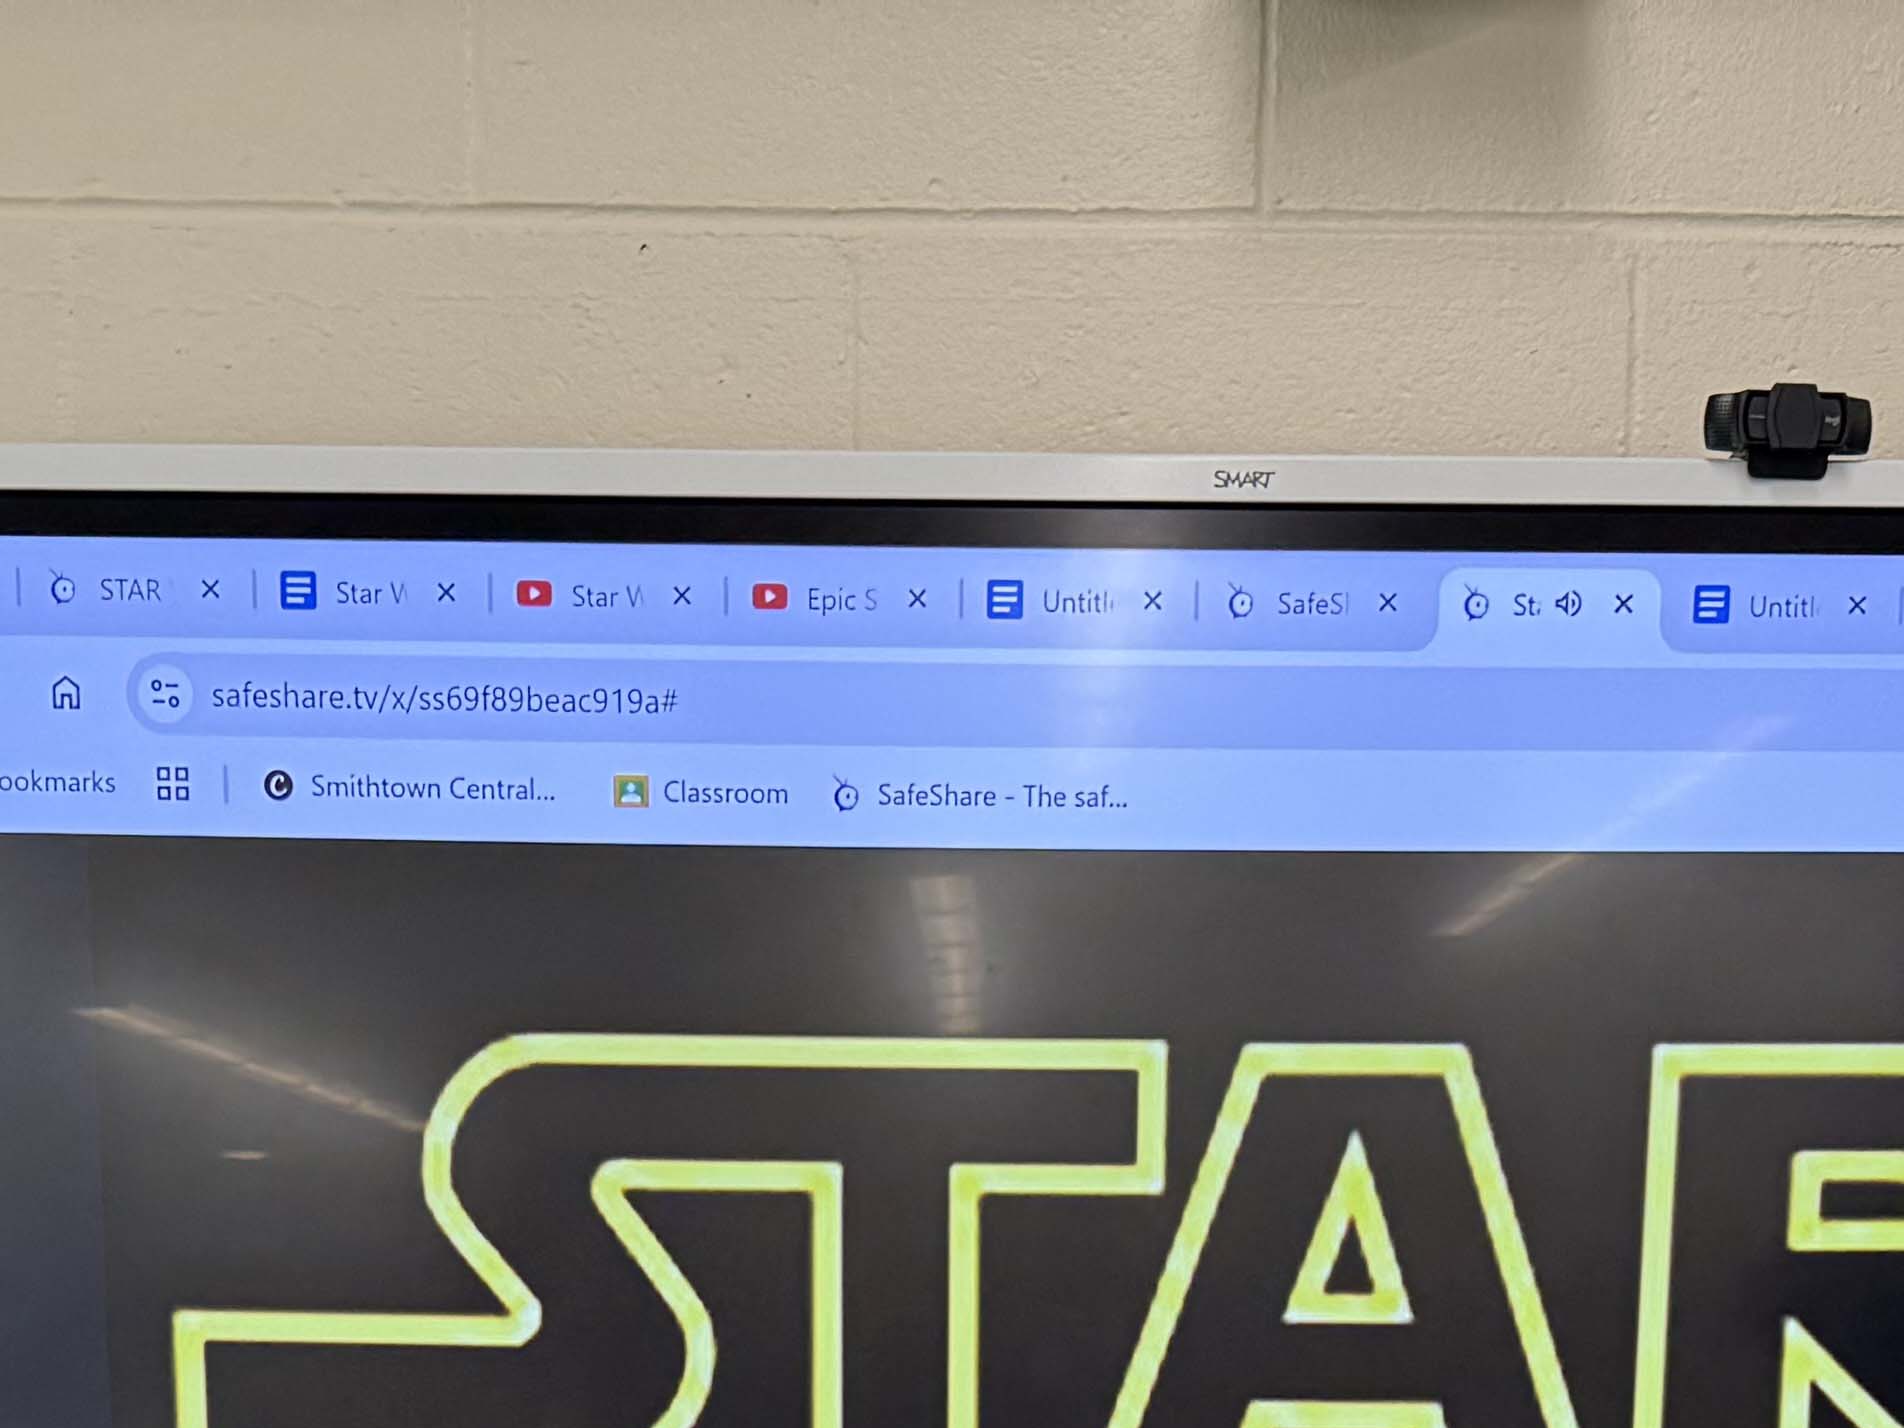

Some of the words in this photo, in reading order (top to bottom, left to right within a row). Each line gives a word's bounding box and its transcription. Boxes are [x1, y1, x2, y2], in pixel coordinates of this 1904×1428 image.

[1213, 470, 1276, 489] SMART
[100, 578, 162, 601] STAR
[336, 581, 383, 605] Star
[572, 584, 619, 608] Star
[808, 587, 857, 616] Epic
[1750, 594, 1818, 618] Untitl
[311, 776, 441, 800] Smithtown
[663, 780, 789, 804] Classroom
[878, 782, 997, 807] SafeShare
[1022, 784, 1067, 808] The
